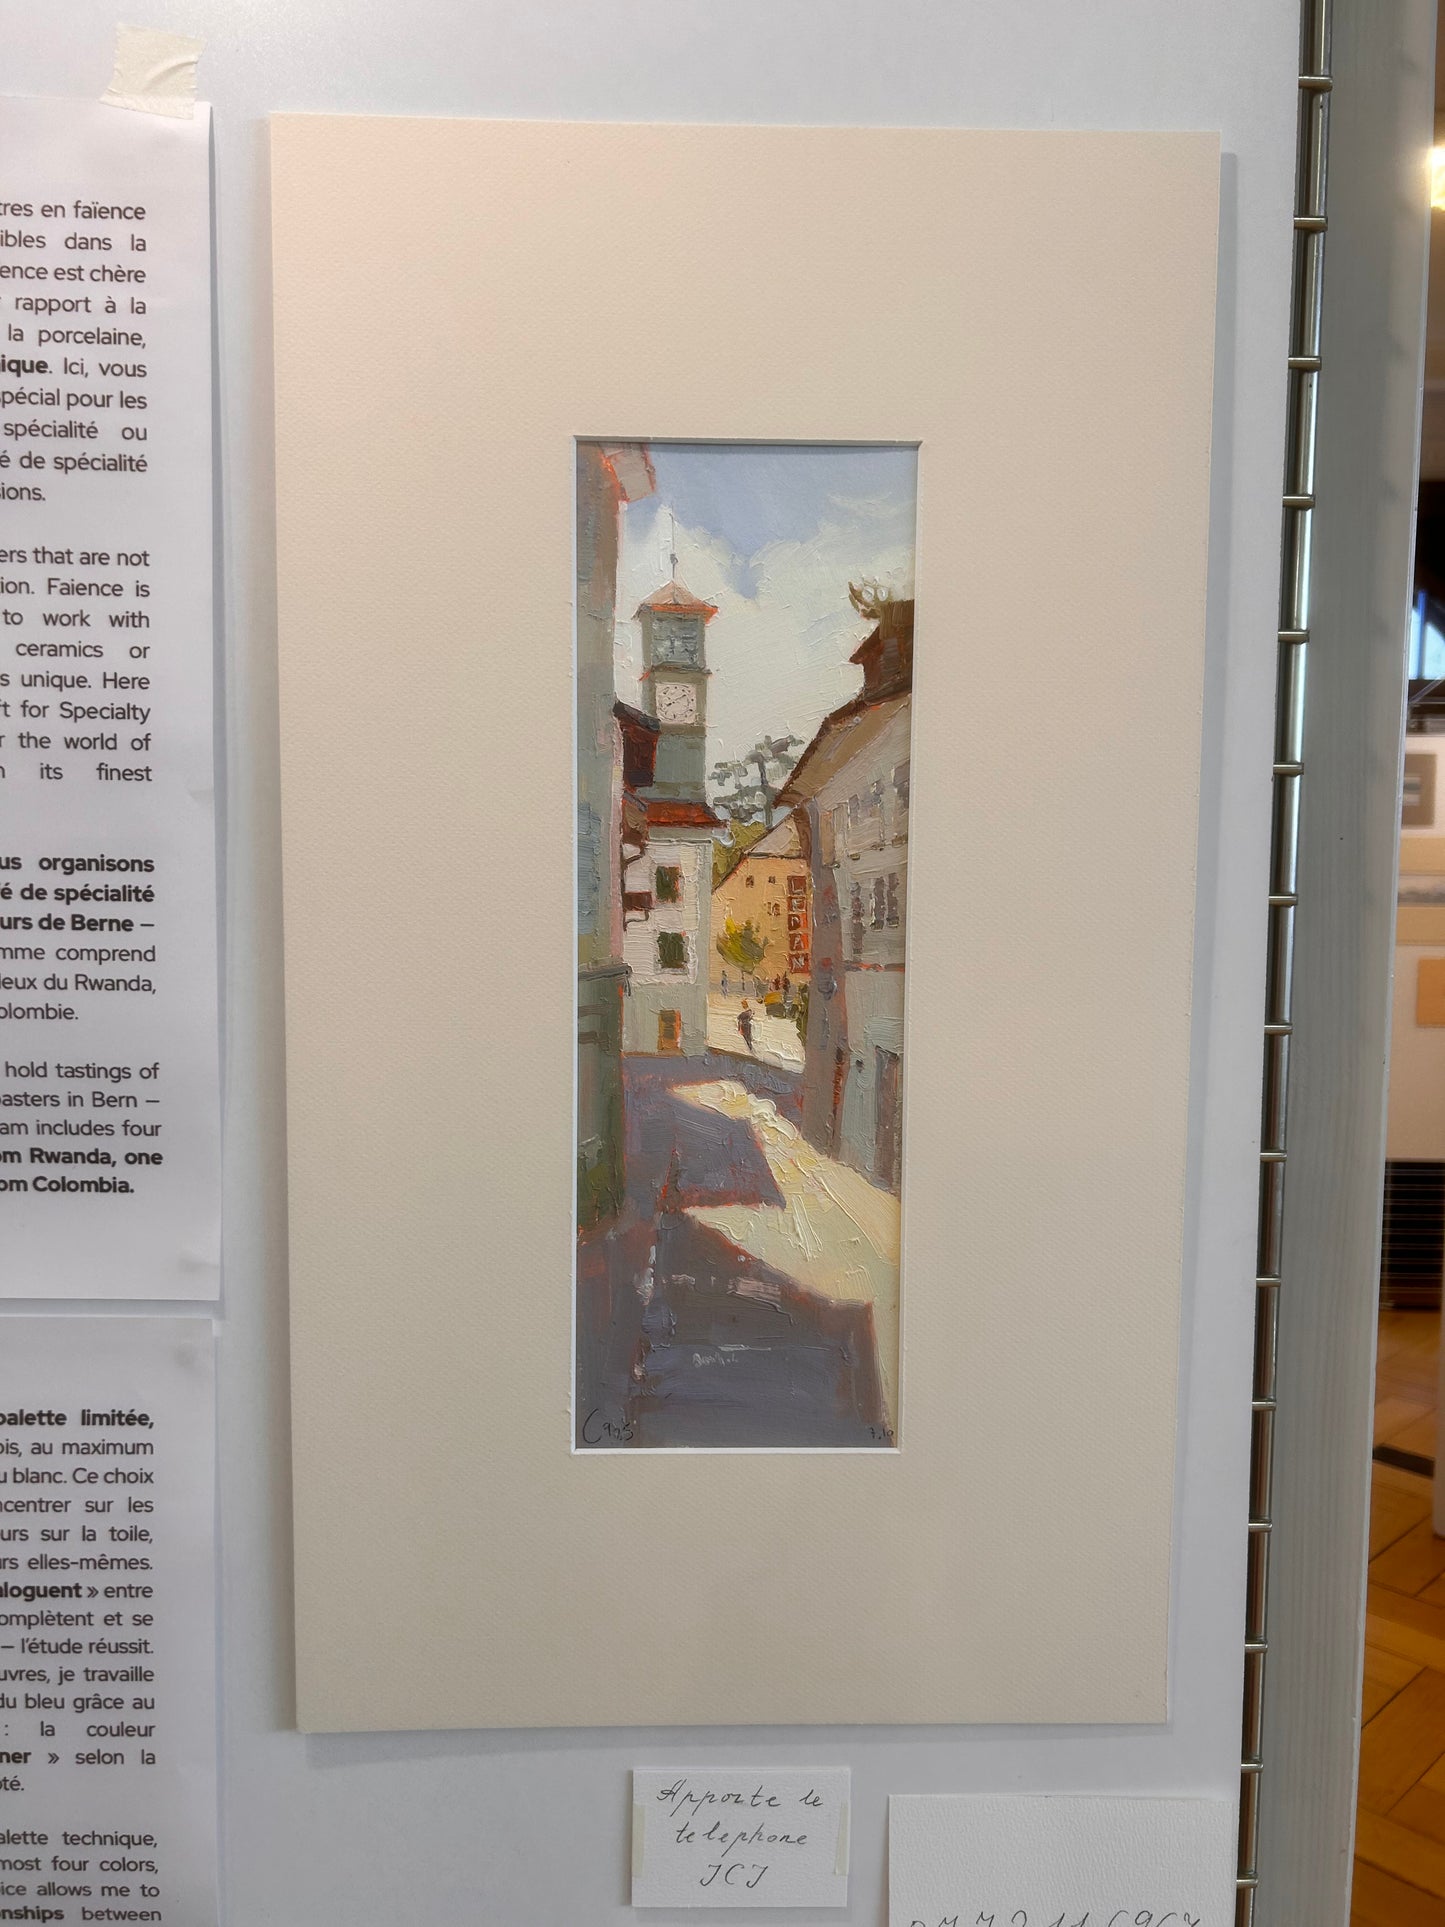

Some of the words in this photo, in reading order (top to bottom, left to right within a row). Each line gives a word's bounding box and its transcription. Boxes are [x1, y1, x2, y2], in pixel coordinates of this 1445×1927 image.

[40, 203, 66, 219] en
[71, 199, 147, 221] faïence
[63, 231, 113, 252] dans
[130, 233, 147, 253] la
[0, 264, 49, 281] ence
[52, 264, 86, 282] est
[88, 263, 147, 284] chère
[14, 296, 93, 317] rapport
[103, 295, 117, 315] à
[130, 296, 147, 315] la
[7, 322, 25, 343] la
[37, 326, 147, 350] porcelaine,
[0, 353, 54, 379] ique.
[63, 356, 89, 379] Ici,
[97, 362, 148, 379] vous
[0, 386, 61, 409] pécial
[65, 392, 115, 412] pour
[119, 389, 148, 410] les
[2, 418, 99, 442] spécialité
[120, 426, 148, 442] ou
[18, 450, 47, 470] de
[52, 451, 149, 476] spécialité
[0, 481, 47, 502] ions.
[0, 548, 28, 564] ers
[31, 545, 75, 566] that
[78, 551, 111, 567] are
[116, 550, 151, 568] not
[46, 577, 125, 598] Faience
[135, 579, 151, 599] is
[1, 608, 24, 626] to
[41, 608, 92, 628] work
[107, 610, 151, 629] with
[14, 640, 105, 659] ceramics
[128, 645, 151, 660] or
[20, 670, 92, 693] unique.
[102, 671, 151, 691] Here
[19, 699, 51, 719] for
[58, 700, 152, 726] Specialty
[16, 730, 52, 750] the
[63, 732, 118, 751] world
[129, 732, 152, 752] of
[39, 762, 64, 781] its
[95, 761, 153, 783] finest
[37, 853, 156, 876] organisons
[19, 882, 49, 902] de
[53, 883, 156, 906] spécialité
[37, 912, 67, 932] de
[70, 913, 135, 933] Berne
[54, 944, 157, 966] comprend
[0, 973, 38, 991] eux
[42, 972, 69, 991] du
[74, 973, 157, 996] Rwanda,
[4, 1060, 48, 1079] hold
[54, 1062, 132, 1084] tastings
[138, 1061, 161, 1080] of
[0, 1091, 61, 1108] asters
[66, 1090, 85, 1108] in
[91, 1090, 138, 1109] Bern
[35, 1118, 116, 1137] includes
[120, 1118, 163, 1137] four
[29, 1146, 118, 1168] Rwanda,
[123, 1151, 164, 1166] one
[31, 1175, 135, 1194] Colombia.
[80, 1408, 155, 1430] limitée,
[30, 1441, 54, 1456] au
[61, 1438, 154, 1456] maximum
[12, 1466, 68, 1485] blanc.
[71, 1466, 100, 1485] Ce
[102, 1467, 155, 1485] choix
[0, 1497, 72, 1514] centrer
[84, 1499, 115, 1514] sur
[127, 1496, 155, 1514] les
[39, 1528, 71, 1542] sur
[81, 1524, 97, 1543] la
[107, 1524, 154, 1545] toile,
[26, 1553, 153, 1571] elles-mêmes.
[102, 1583, 154, 1599] entre
[102, 1611, 124, 1627] et
[131, 1613, 154, 1627] se
[20, 1637, 84, 1655] l’étude
[88, 1637, 154, 1655] réussit.
[57, 1665, 76, 1687] je
[82, 1665, 155, 1683] travaille
[24, 1692, 66, 1710] bleu
[72, 1692, 125, 1714] grâce
[131, 1697, 156, 1711] au
[39, 1720, 56, 1737] la
[85, 1720, 157, 1738] couleur
[74, 1748, 125, 1766] selon
[140, 1748, 157, 1766] la
[799, 1788, 824, 1807] le
[61, 1829, 158, 1850] technique,
[50, 1855, 90, 1872] four
[98, 1856, 159, 1875] colors,
[0, 1881, 27, 1897] ice
[36, 1881, 93, 1897] allows
[100, 1885, 131, 1898] me
[139, 1883, 161, 1898] to
[0, 1905, 65, 1924] nships
[81, 1906, 162, 1922] between
